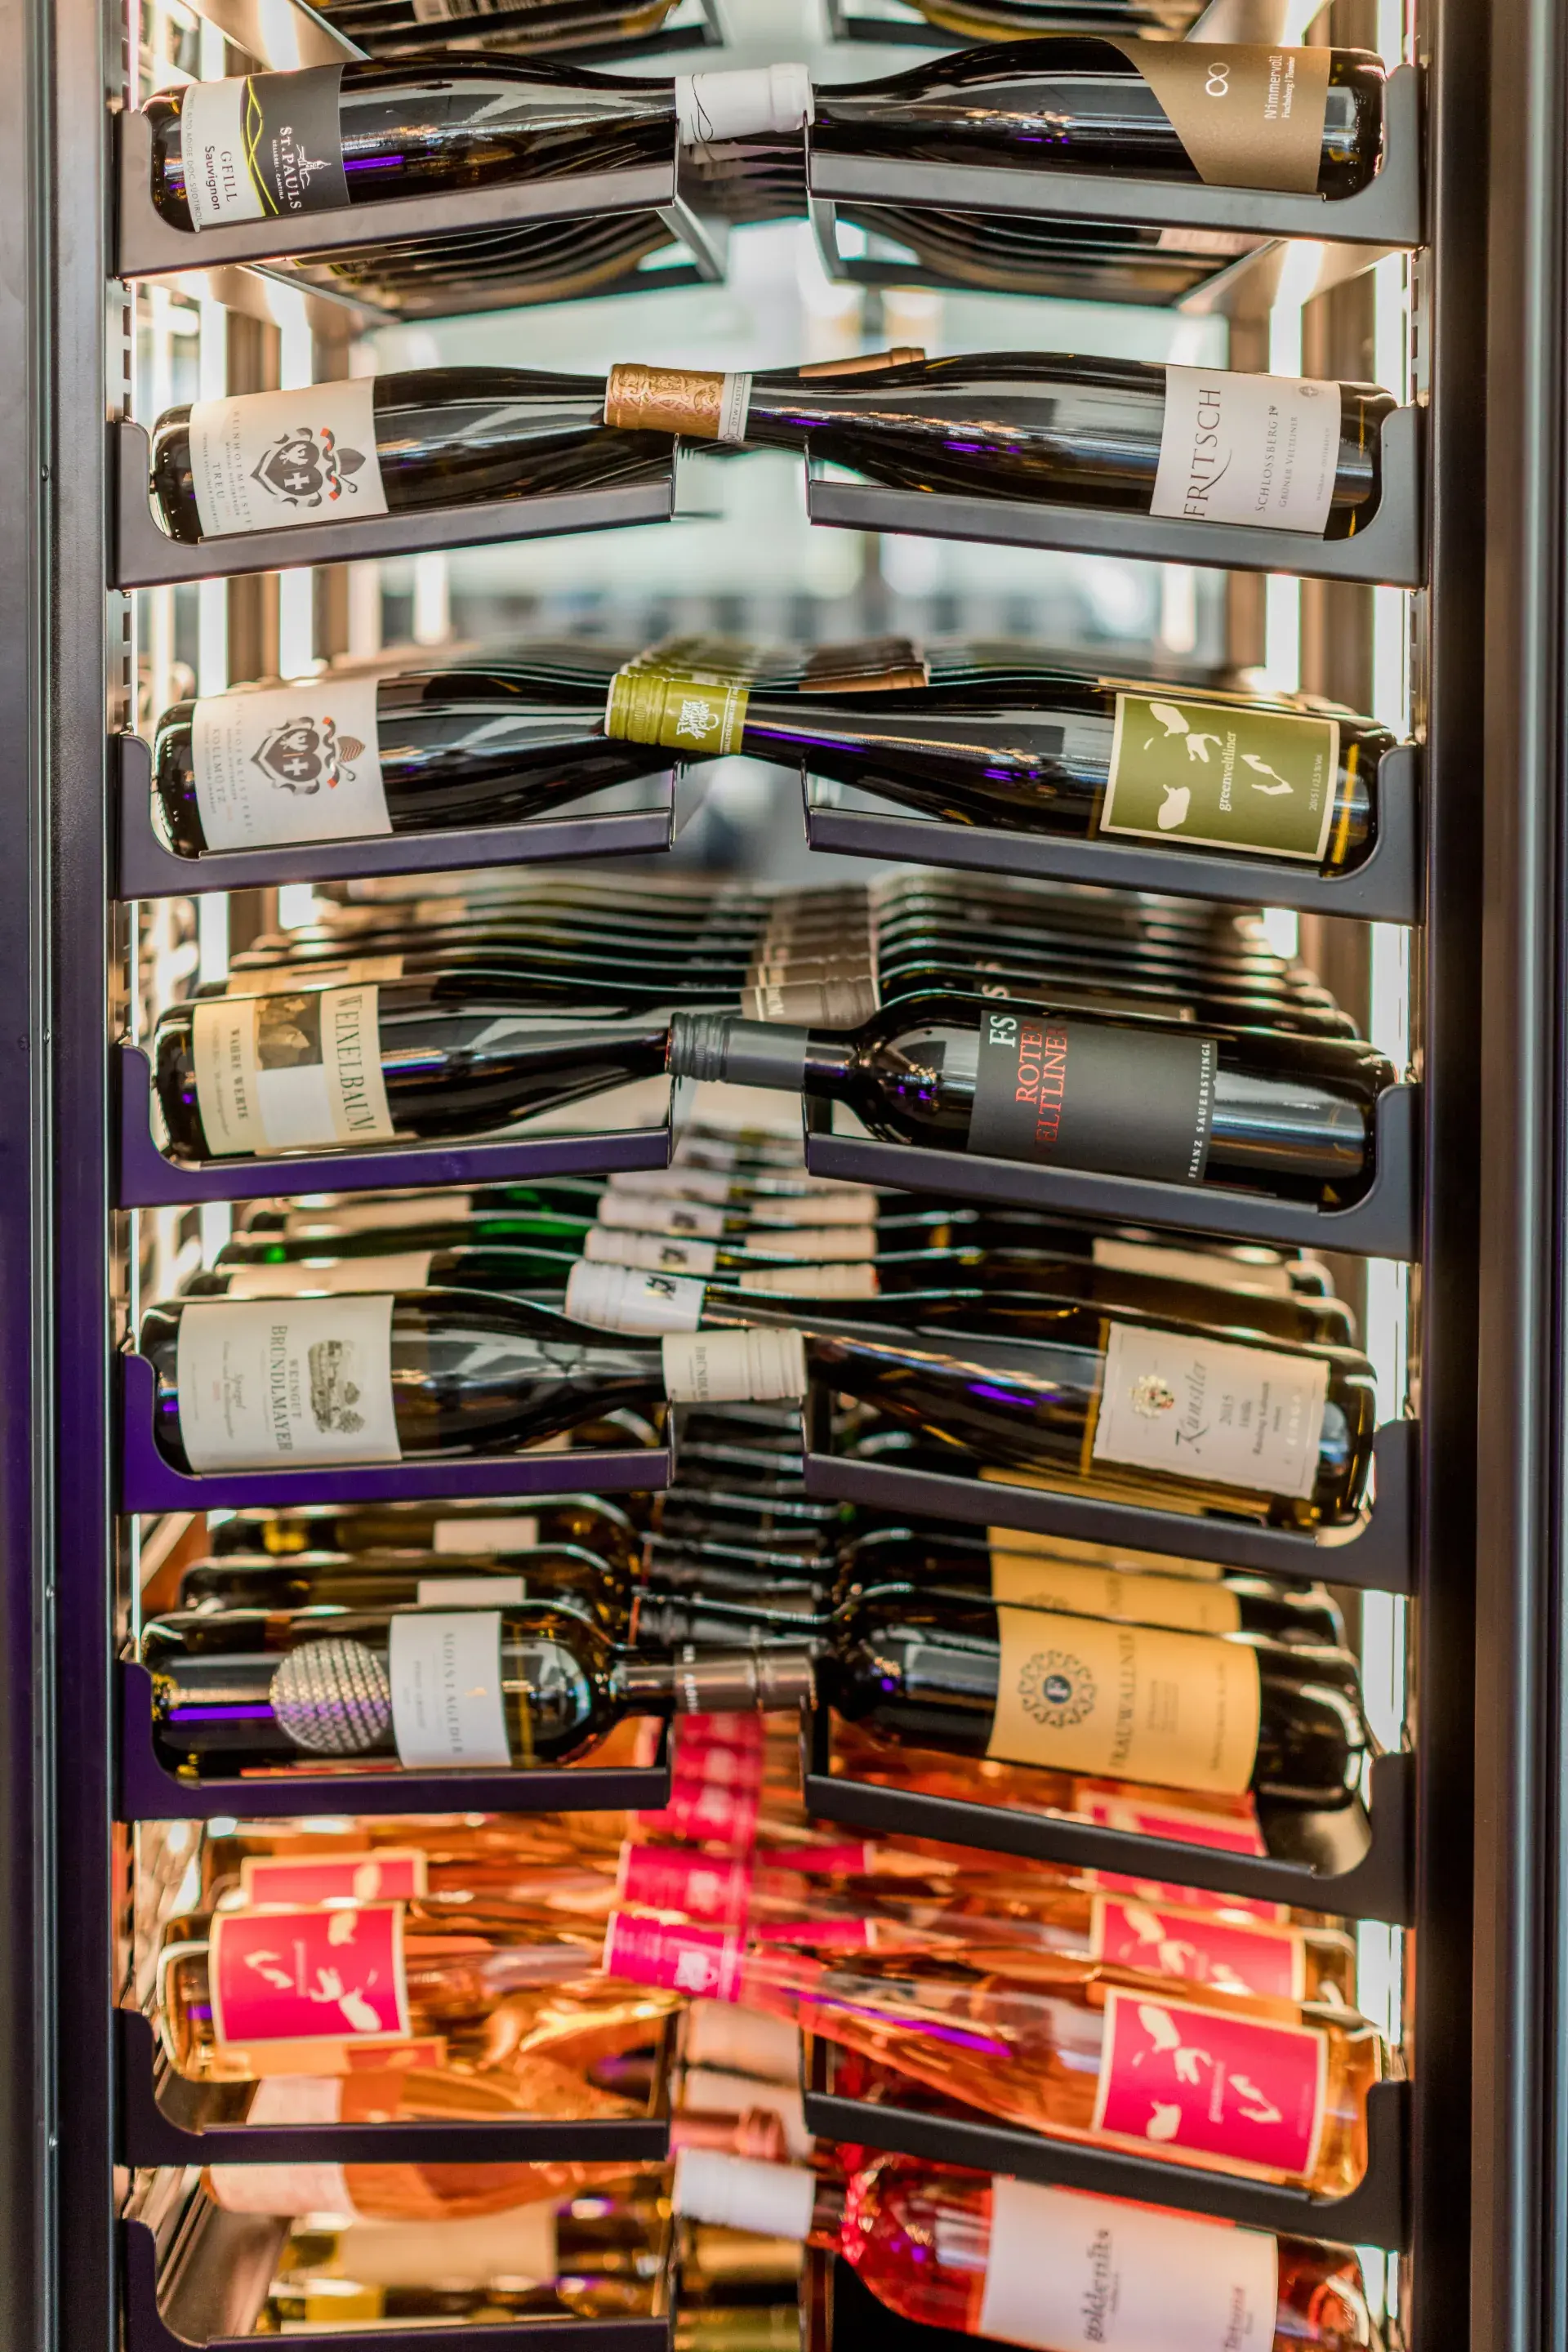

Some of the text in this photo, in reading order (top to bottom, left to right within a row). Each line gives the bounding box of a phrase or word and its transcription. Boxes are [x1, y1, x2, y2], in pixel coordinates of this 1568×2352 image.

[1264, 56, 1283, 119] Nimmervoll
[185, 133, 194, 157] ADIGE
[186, 160, 196, 180] DOC
[204, 145, 220, 211] Sauvignon
[220, 151, 238, 203] GFILL
[1183, 389, 1232, 517] FRITSCH
[1255, 421, 1278, 512] SCHLOSSBERG
[1285, 416, 1298, 466] VELTLINER
[212, 461, 225, 500] TREU
[1219, 731, 1236, 812] greenveltliner
[989, 1015, 1018, 1048] FS
[336, 994, 376, 1133] WEIXELBAUM
[234, 1076, 248, 1120] WERTE
[1188, 1139, 1203, 1178] FRANZ
[289, 1358, 302, 1419] WEINGUT
